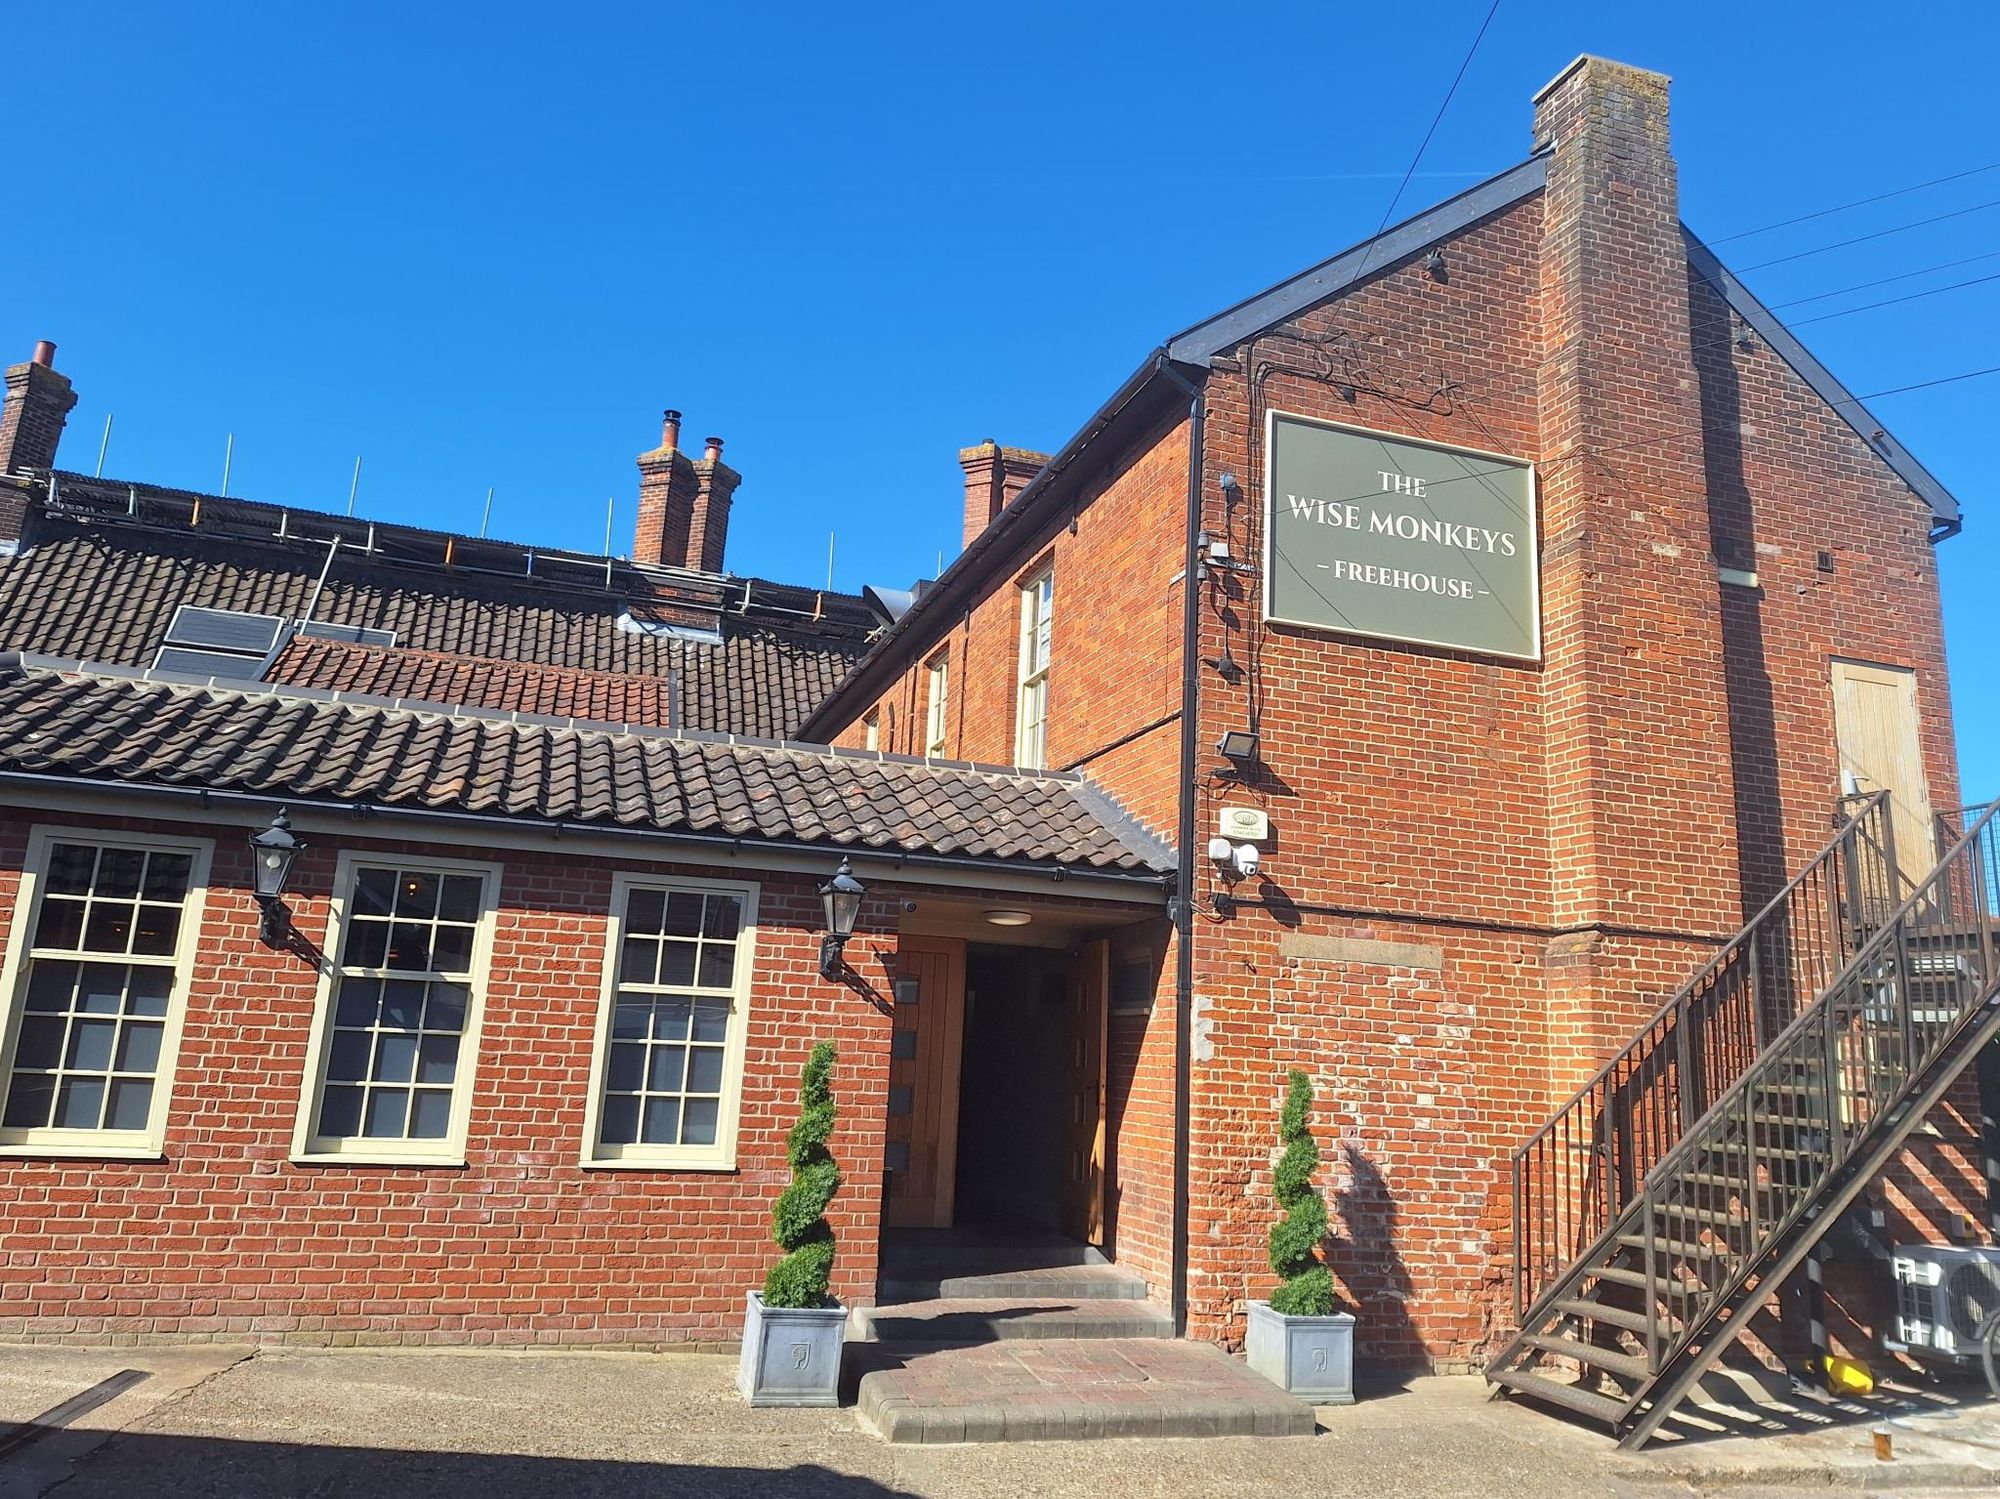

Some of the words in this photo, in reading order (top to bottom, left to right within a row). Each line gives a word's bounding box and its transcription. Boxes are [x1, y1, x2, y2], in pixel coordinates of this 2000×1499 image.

[1377, 470, 1427, 498] THE
[1287, 494, 1361, 530] WISE
[1367, 509, 1517, 557] MONKEYS
